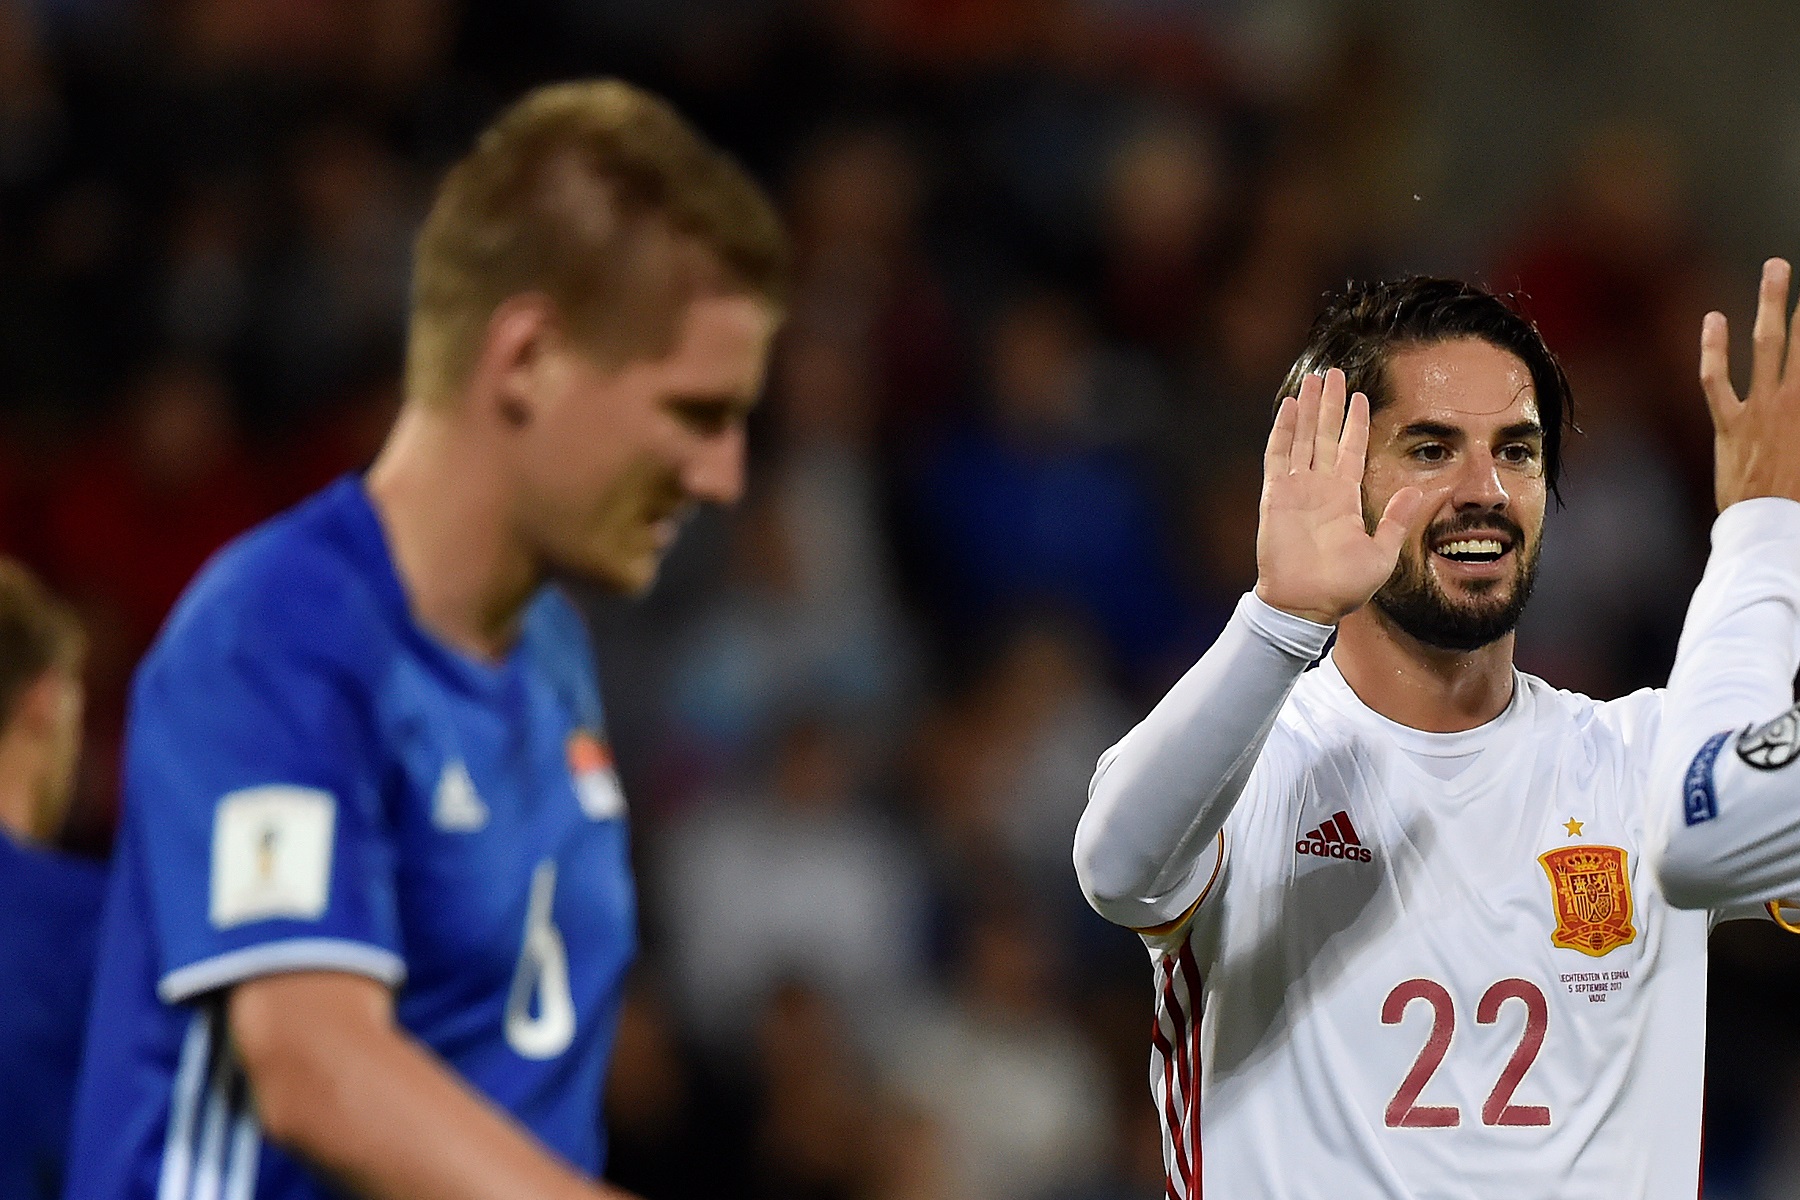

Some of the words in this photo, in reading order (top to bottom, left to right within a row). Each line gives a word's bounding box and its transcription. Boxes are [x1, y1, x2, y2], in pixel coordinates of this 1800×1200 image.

[1296, 840, 1371, 863] adidas
[505, 858, 576, 1061] 6
[1568, 984, 1573, 993] 5
[1575, 983, 1608, 993] SEPTIEMBRE
[1610, 982, 1621, 991] 2017
[1381, 978, 1551, 1127] 22
